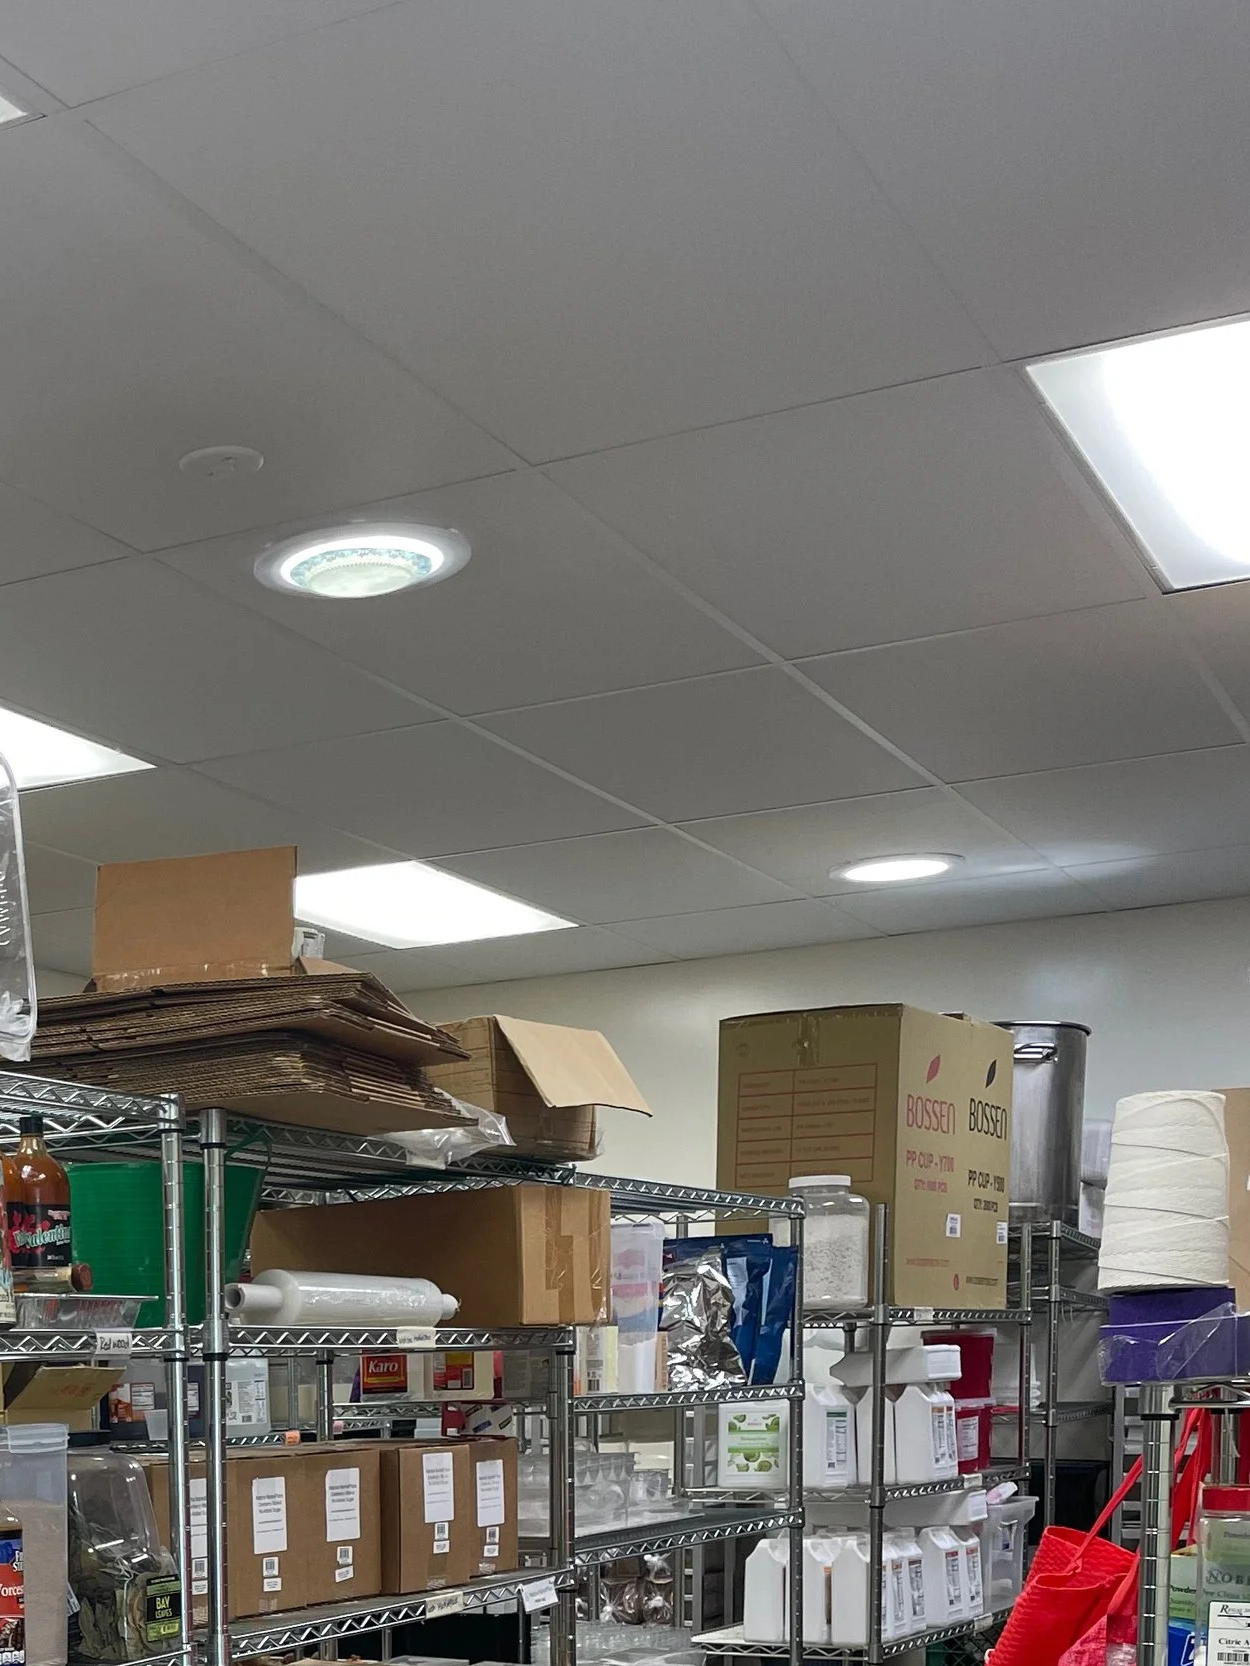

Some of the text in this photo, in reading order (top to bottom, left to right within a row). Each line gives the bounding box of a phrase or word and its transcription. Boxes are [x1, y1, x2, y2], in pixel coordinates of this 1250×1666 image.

[907, 1094, 956, 1136] BOSSEN
[969, 1098, 1008, 1140] BOSSEN
[906, 1150, 917, 1168] PP
[968, 1170, 978, 1187] PP
[368, 1359, 398, 1373] Karo
[156, 1596, 170, 1609] BAY
